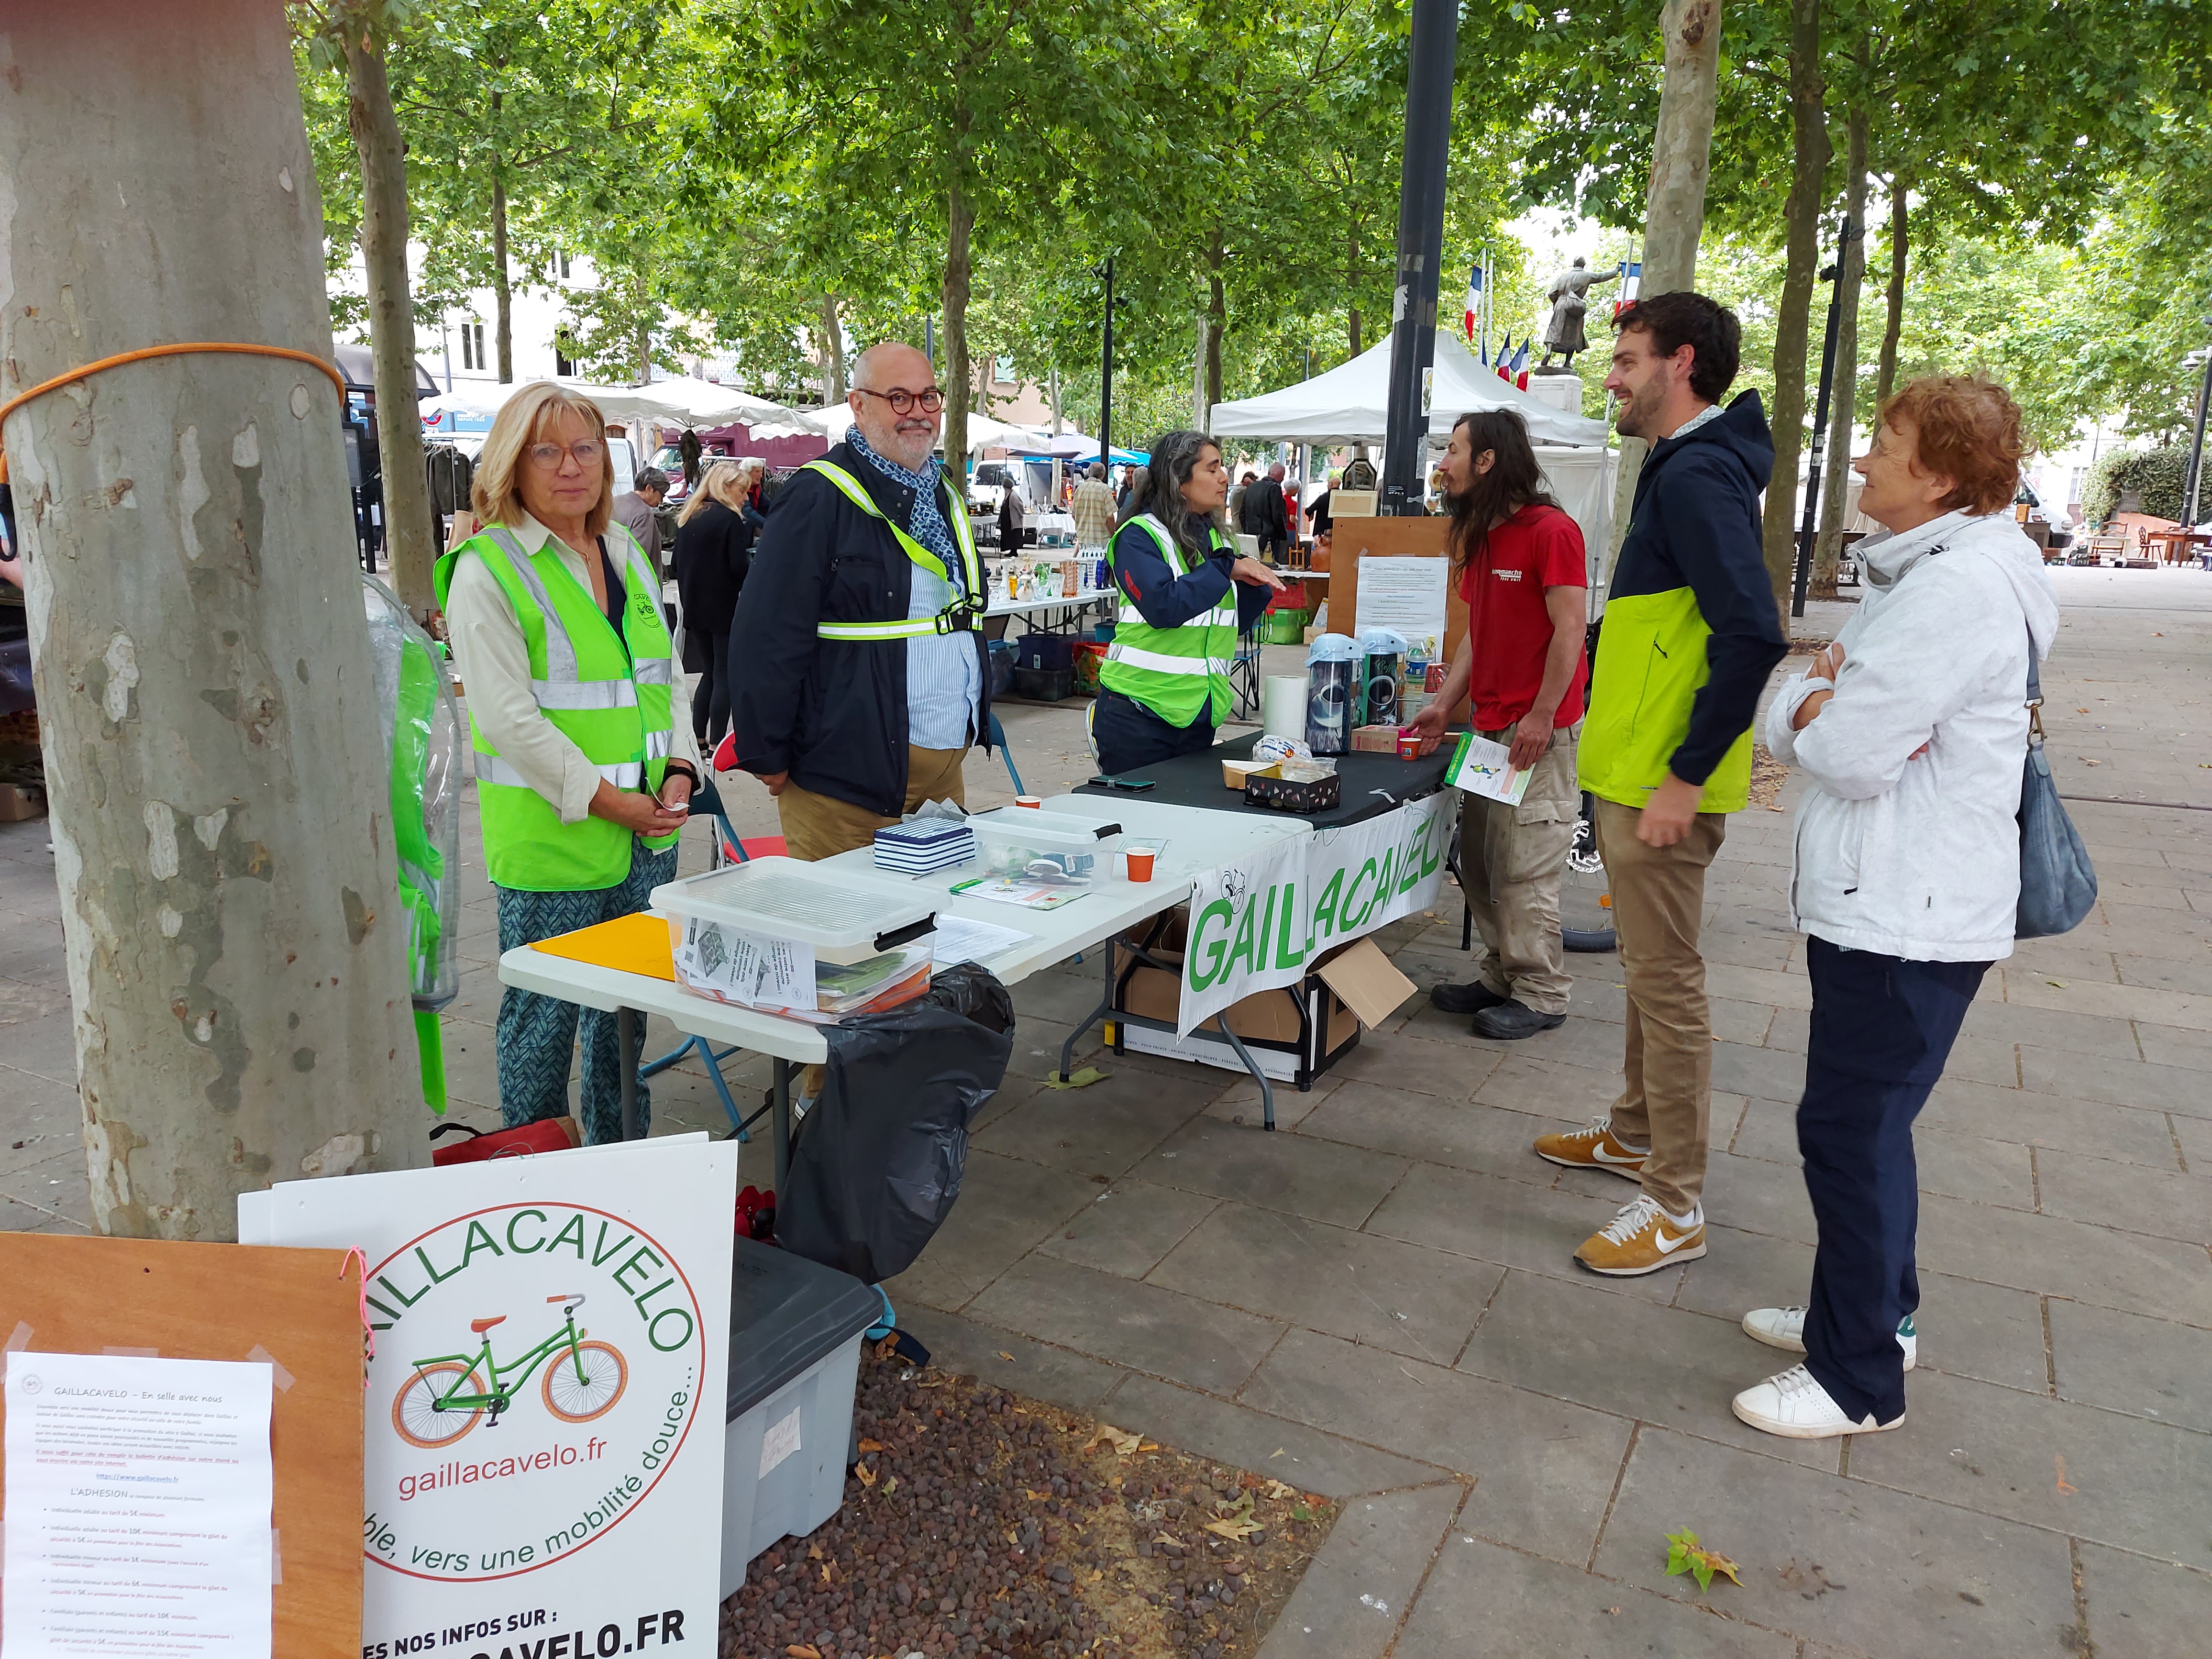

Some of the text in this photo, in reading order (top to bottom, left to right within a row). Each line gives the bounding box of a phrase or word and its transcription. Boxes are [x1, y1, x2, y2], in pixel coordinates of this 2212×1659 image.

[54, 1387, 128, 1398] GAILLACAVELO
[157, 1392, 176, 1401] selle
[71, 1488, 128, 1498] L'ADHESION
[399, 1437, 608, 1501] gaillacavelo.fr
[411, 1545, 469, 1572] vers
[481, 1545, 534, 1571] une
[545, 1473, 642, 1554] mobilité
[642, 1367, 692, 1470] douce...
[395, 1633, 436, 1657] NOS
[442, 1618, 501, 1646] INFOS
[507, 1609, 545, 1632] SUR
